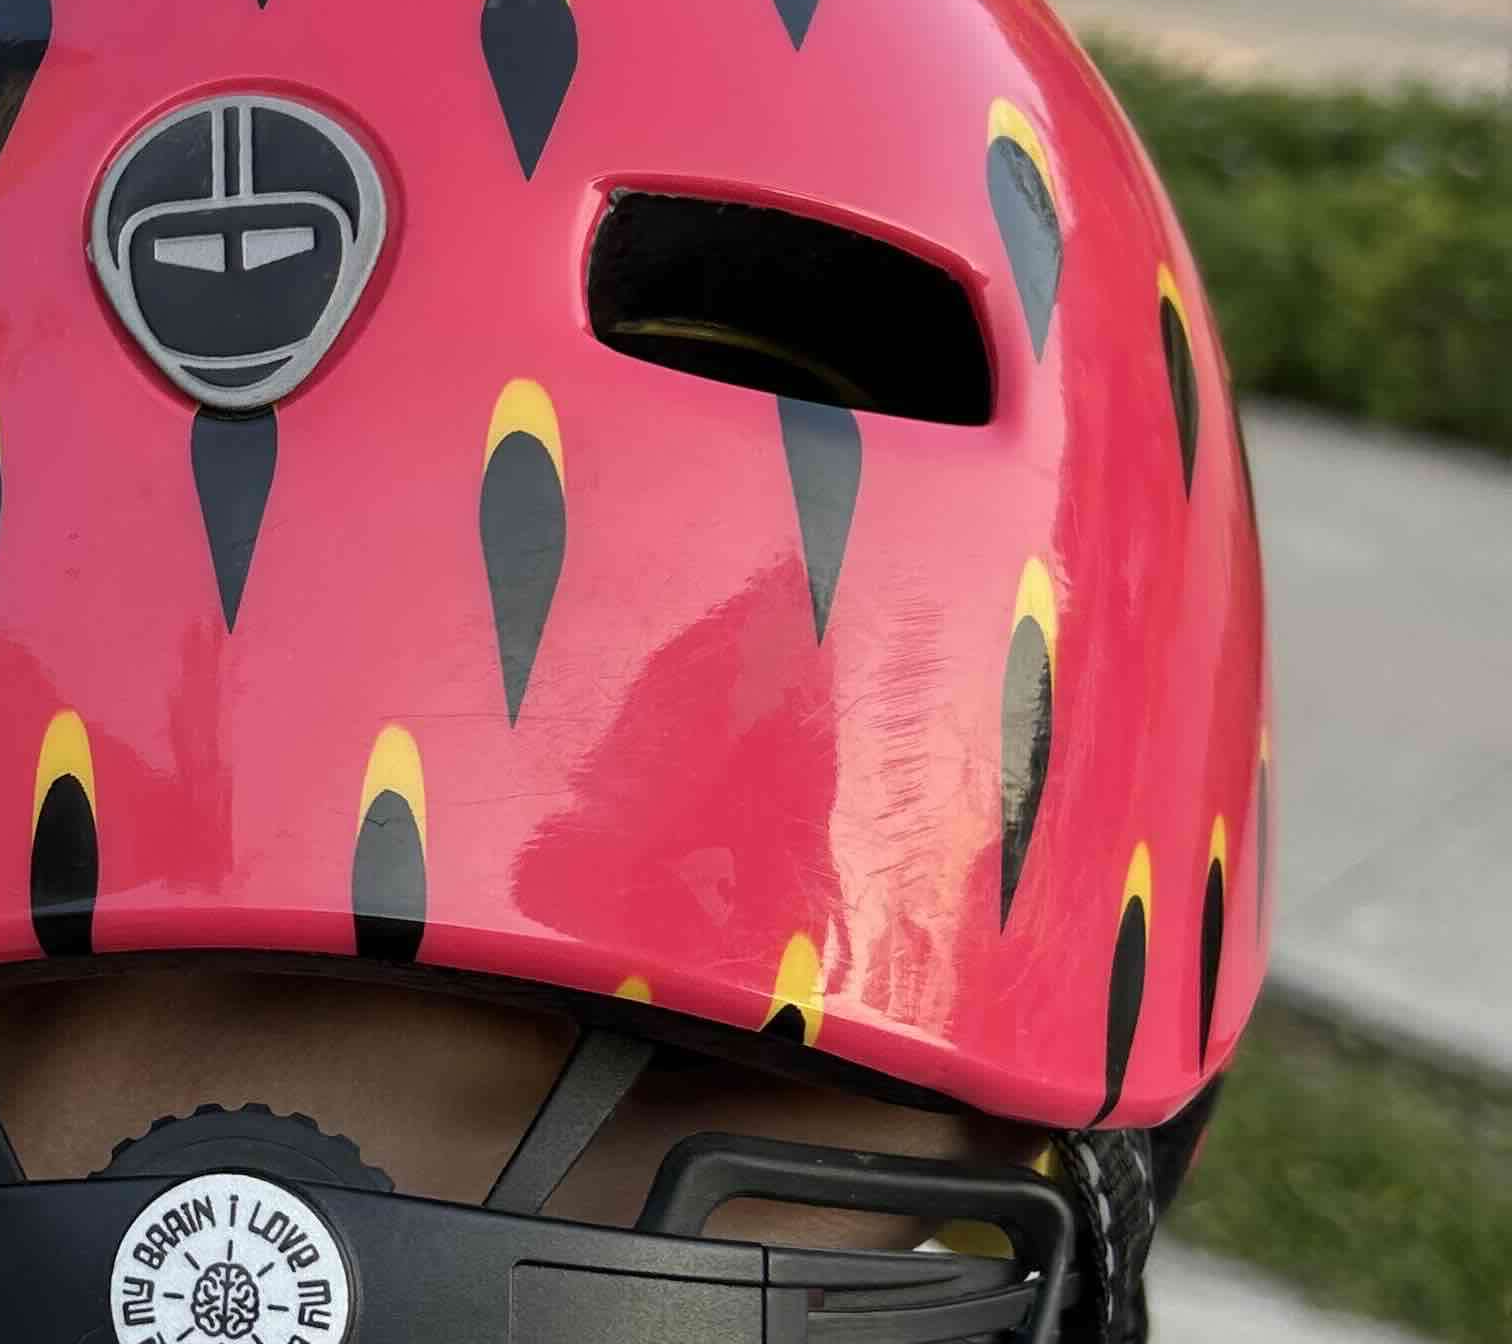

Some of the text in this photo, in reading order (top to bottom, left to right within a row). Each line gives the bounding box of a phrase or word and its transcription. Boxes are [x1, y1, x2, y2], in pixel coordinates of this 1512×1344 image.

[132, 1195, 217, 1270] BRAIN
[229, 1194, 239, 1228] I
[248, 1200, 320, 1273] LOVE
